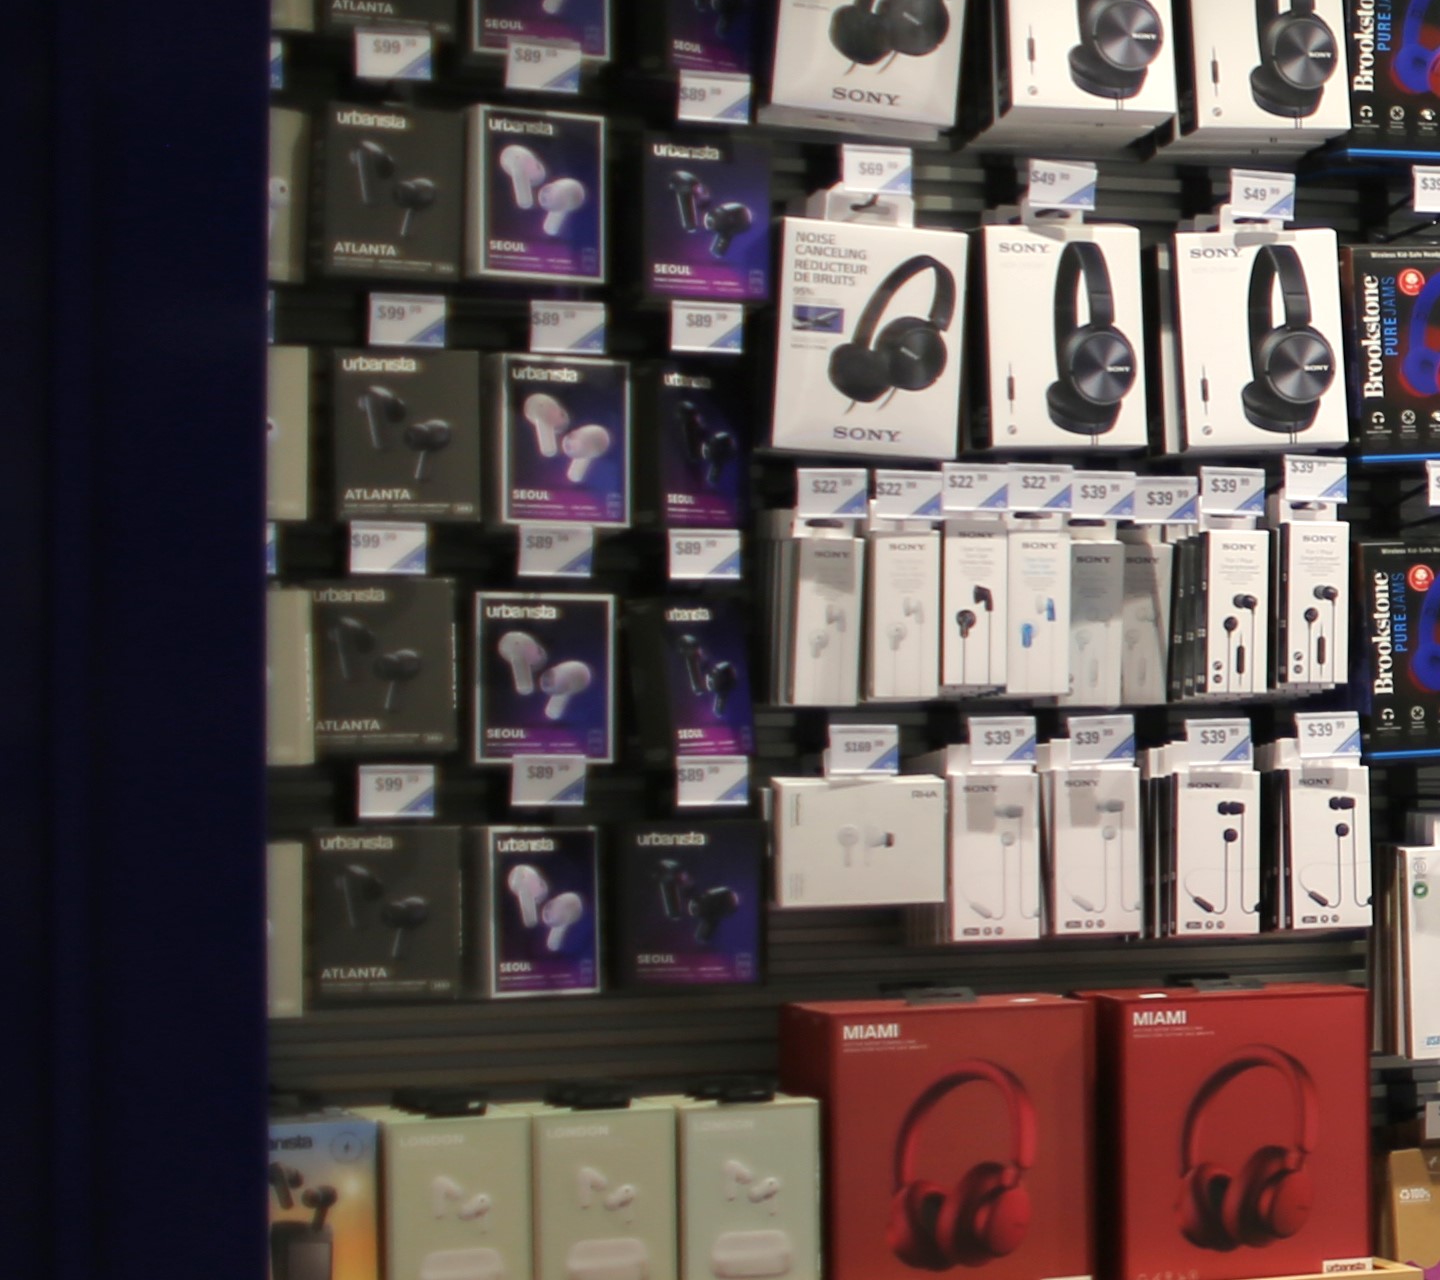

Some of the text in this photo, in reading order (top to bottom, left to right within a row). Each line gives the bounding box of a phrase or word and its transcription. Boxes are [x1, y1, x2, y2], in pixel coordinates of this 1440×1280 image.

[832, 87, 900, 106] SONY
[336, 111, 406, 129] urbanista
[489, 117, 553, 136] urbanista
[653, 143, 720, 160] urbanista
[333, 241, 396, 256] ATLANTA
[489, 240, 526, 253] SEOUL
[999, 242, 1049, 254] SONY
[653, 263, 691, 276] SEOUL
[1385, 275, 1397, 356] PUREJAMS
[1363, 273, 1385, 399] Brookstone
[833, 426, 901, 443] SONY
[1373, 570, 1390, 695] Brookstone
[1132, 1010, 1187, 1027] MIAMI
[842, 1023, 900, 1041] MIAMI
